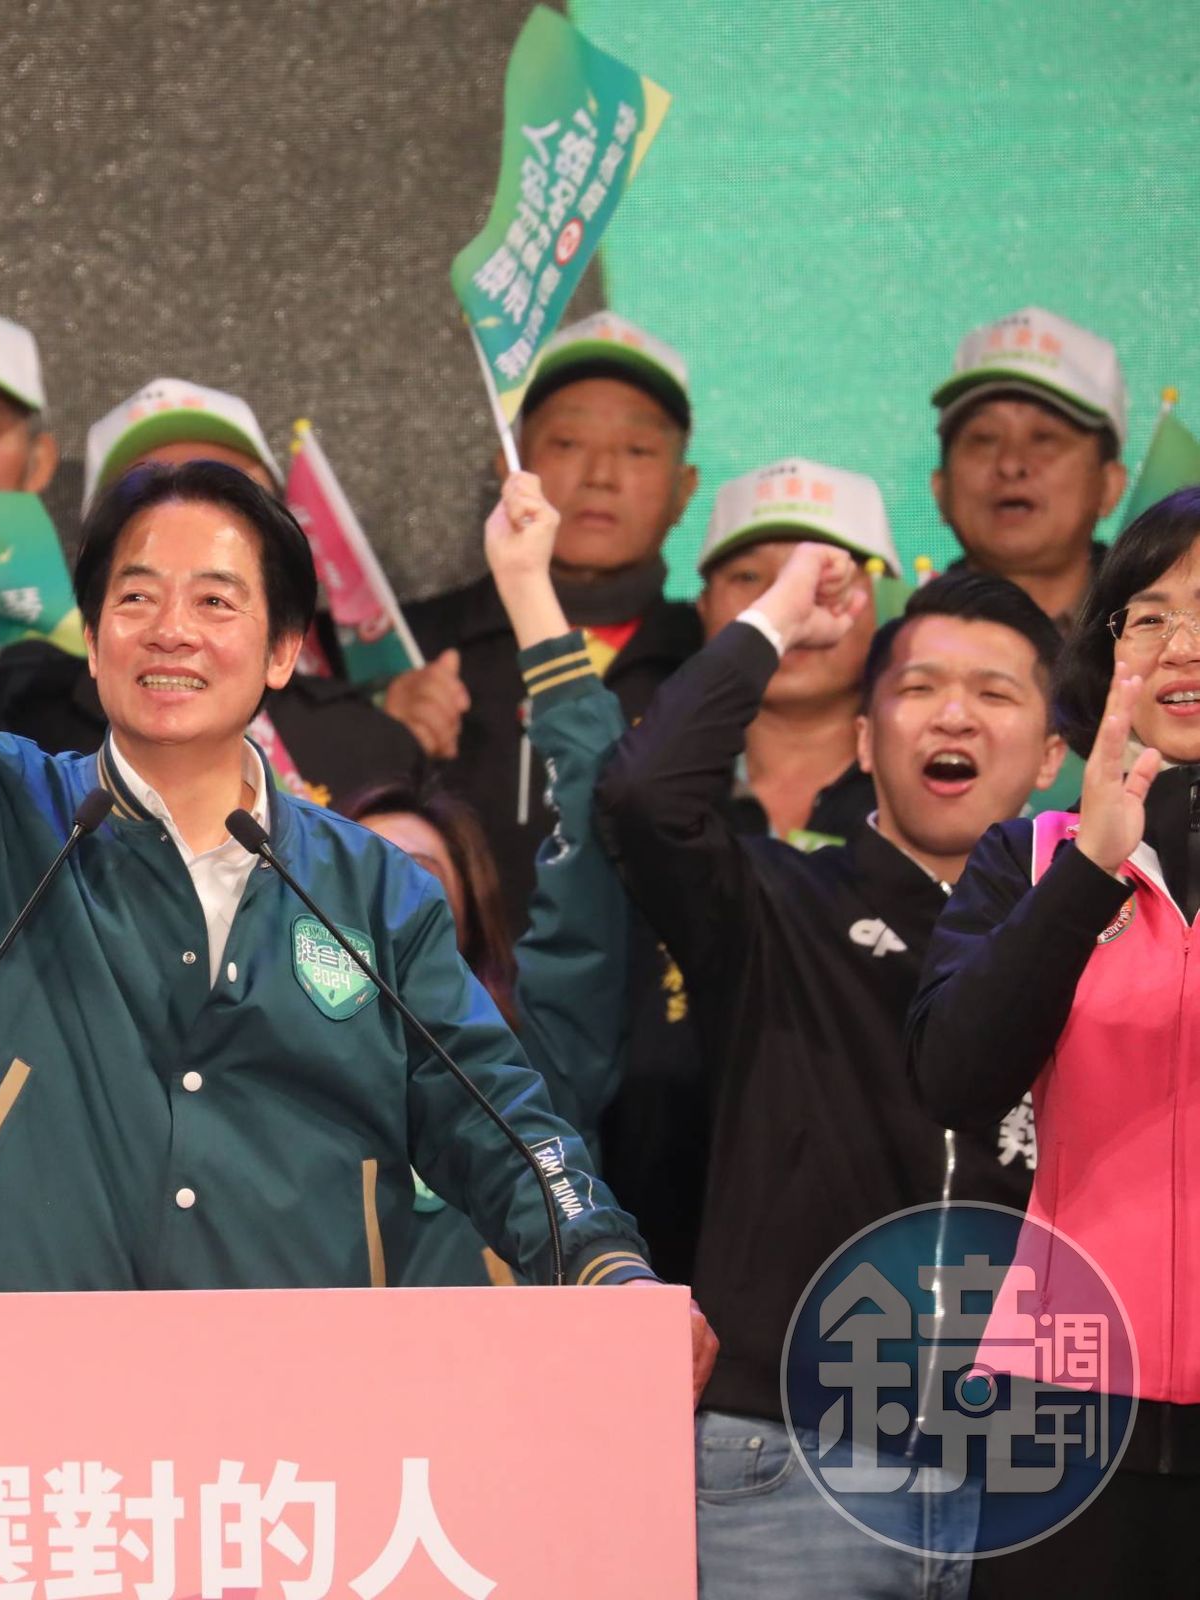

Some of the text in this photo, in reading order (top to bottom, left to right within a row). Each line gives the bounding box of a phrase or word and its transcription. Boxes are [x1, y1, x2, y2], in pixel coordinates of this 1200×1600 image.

[312, 965, 352, 990] 2024
[534, 1146, 584, 1221] EAM TAIWA
